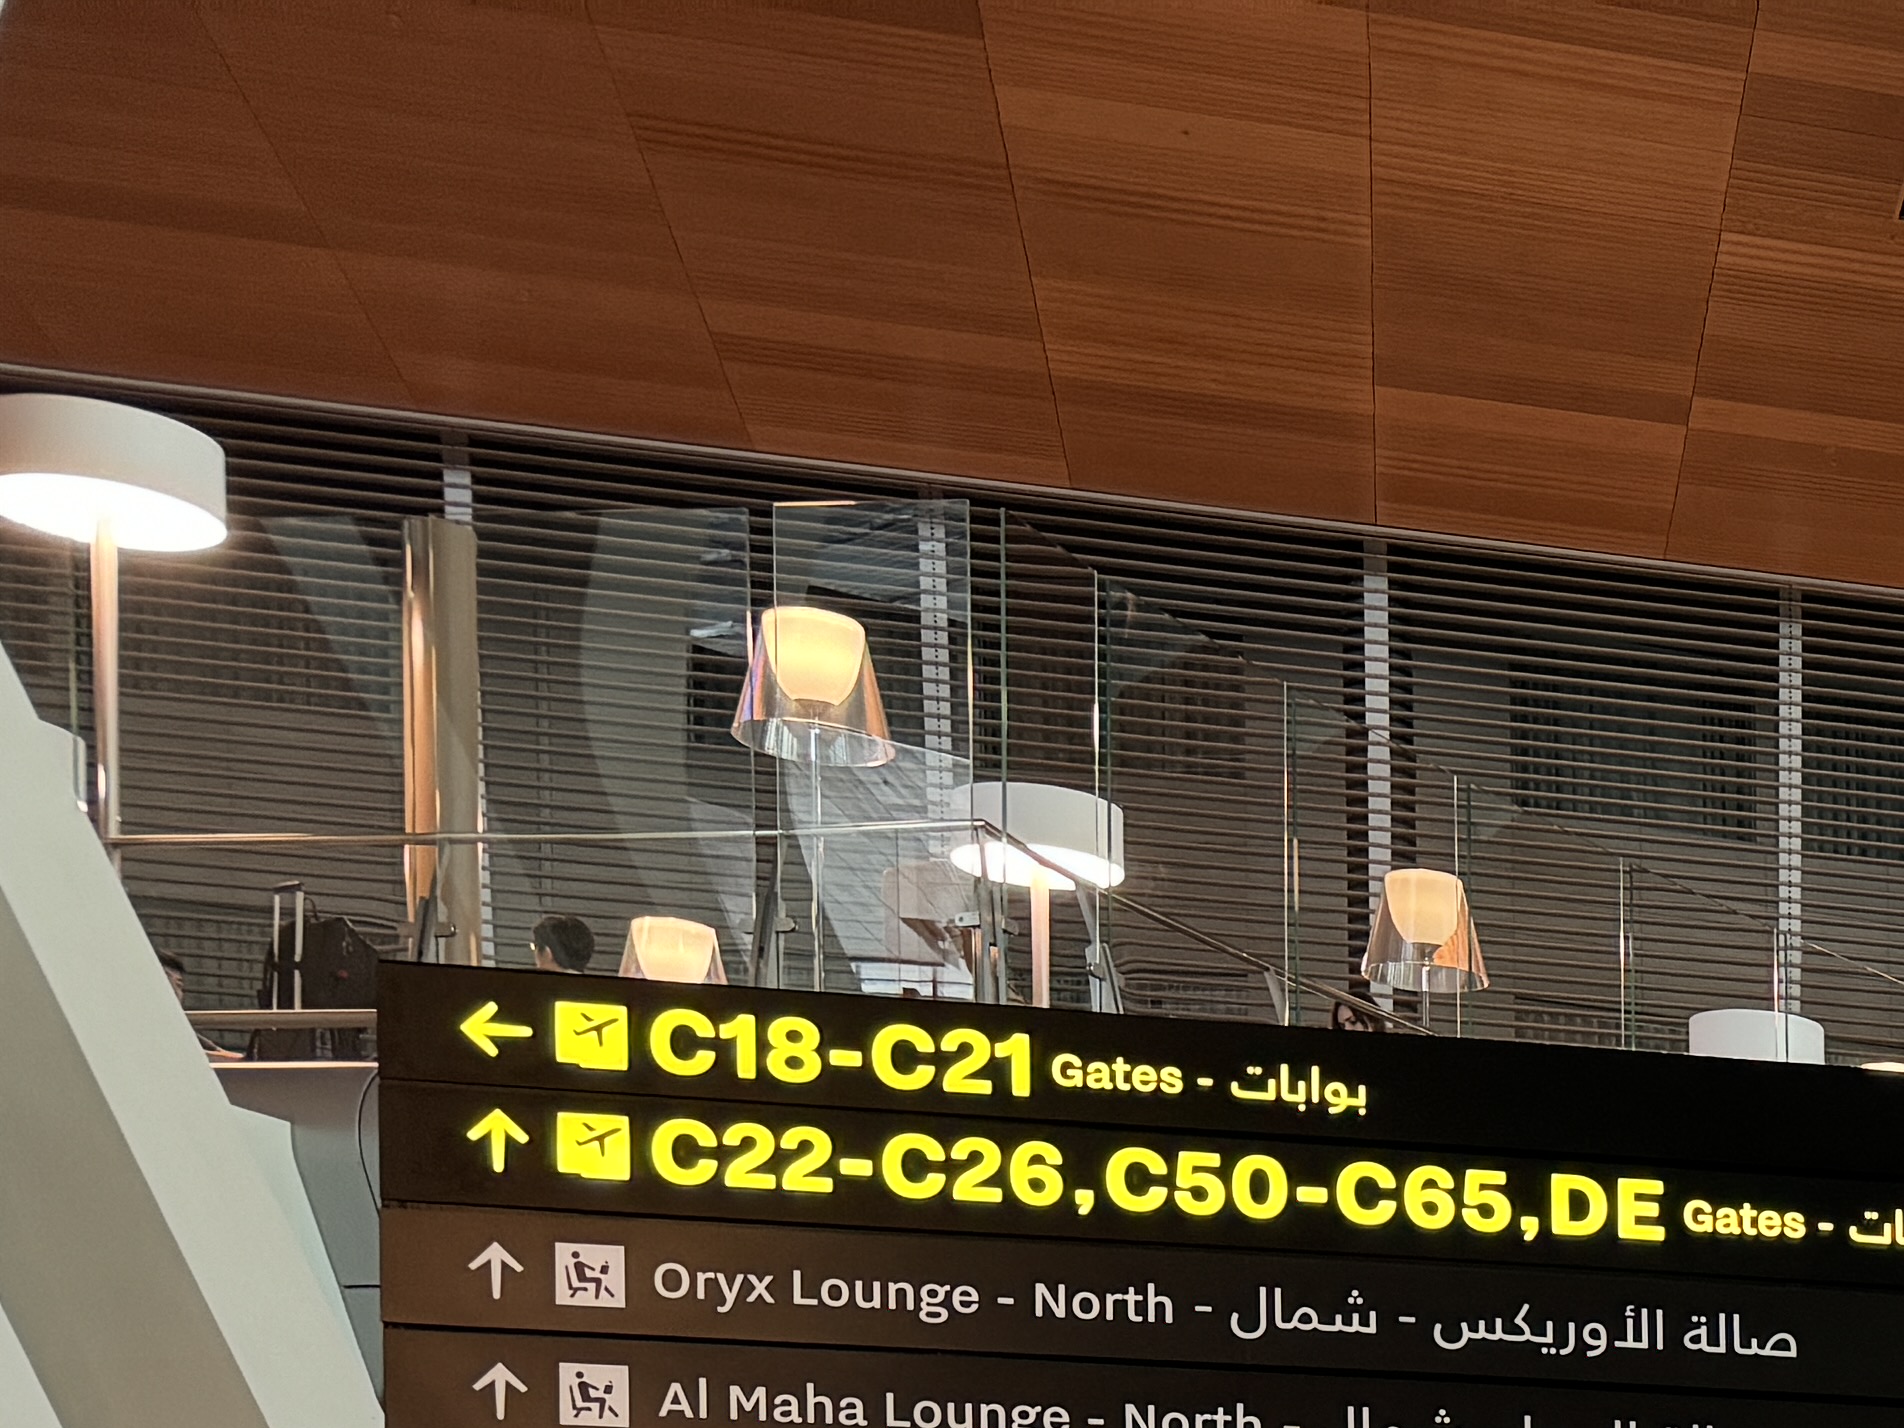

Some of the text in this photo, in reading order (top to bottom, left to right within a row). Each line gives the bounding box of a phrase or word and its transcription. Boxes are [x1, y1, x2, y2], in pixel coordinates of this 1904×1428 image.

[649, 1007, 1032, 1097] C18-C21
[1052, 1053, 1183, 1093] Gates
[1231, 1064, 1366, 1115] بوابات
[651, 1117, 1665, 1241] C22-C26,C50-C65,DE
[1683, 1200, 1806, 1238] Gates
[654, 1263, 774, 1312] Oryx
[793, 1270, 979, 1323] Lounge
[1036, 1283, 1172, 1323] North
[1231, 1287, 1376, 1339] شمال
[1434, 1304, 1663, 1356] الأوريكس
[1684, 1313, 1796, 1357] صالة
[659, 1378, 707, 1418] Al
[730, 1383, 867, 1426] Maha
